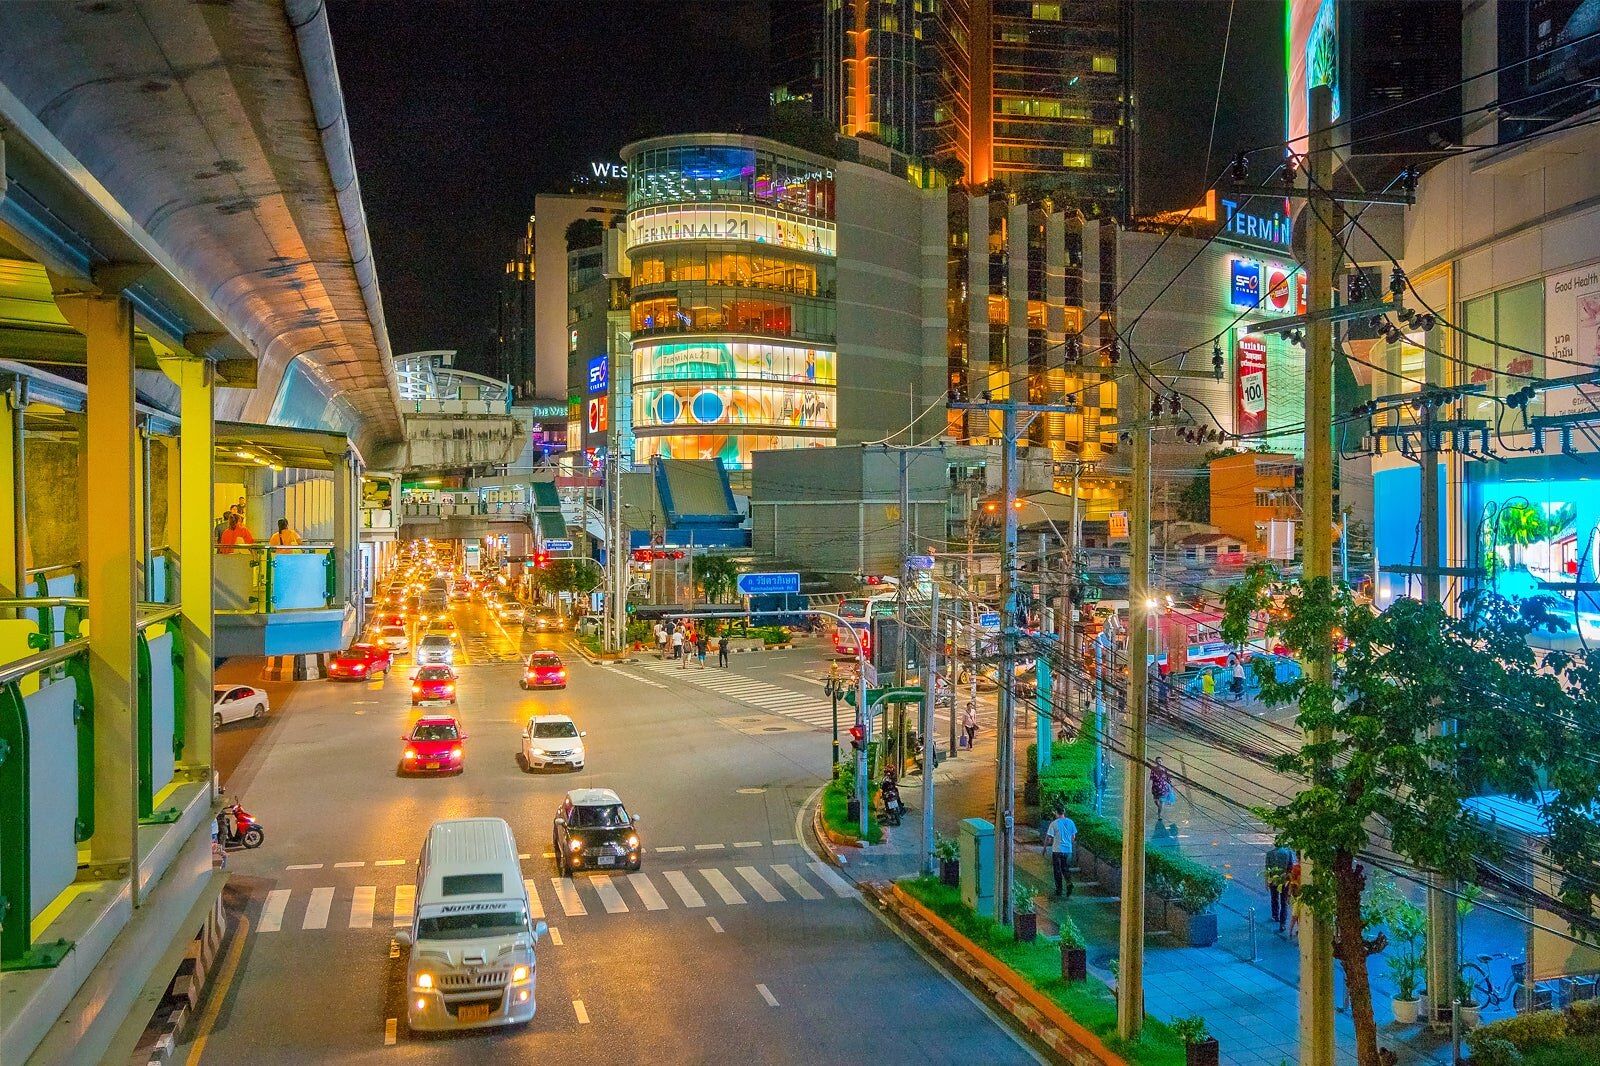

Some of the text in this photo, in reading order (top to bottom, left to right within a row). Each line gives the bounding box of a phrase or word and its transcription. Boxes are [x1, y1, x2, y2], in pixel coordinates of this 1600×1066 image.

[592, 162, 628, 178] WES
[1555, 271, 1599, 293] Good Health
[1554, 333, 1571, 344] นวด
[1245, 383, 1262, 402] 100
